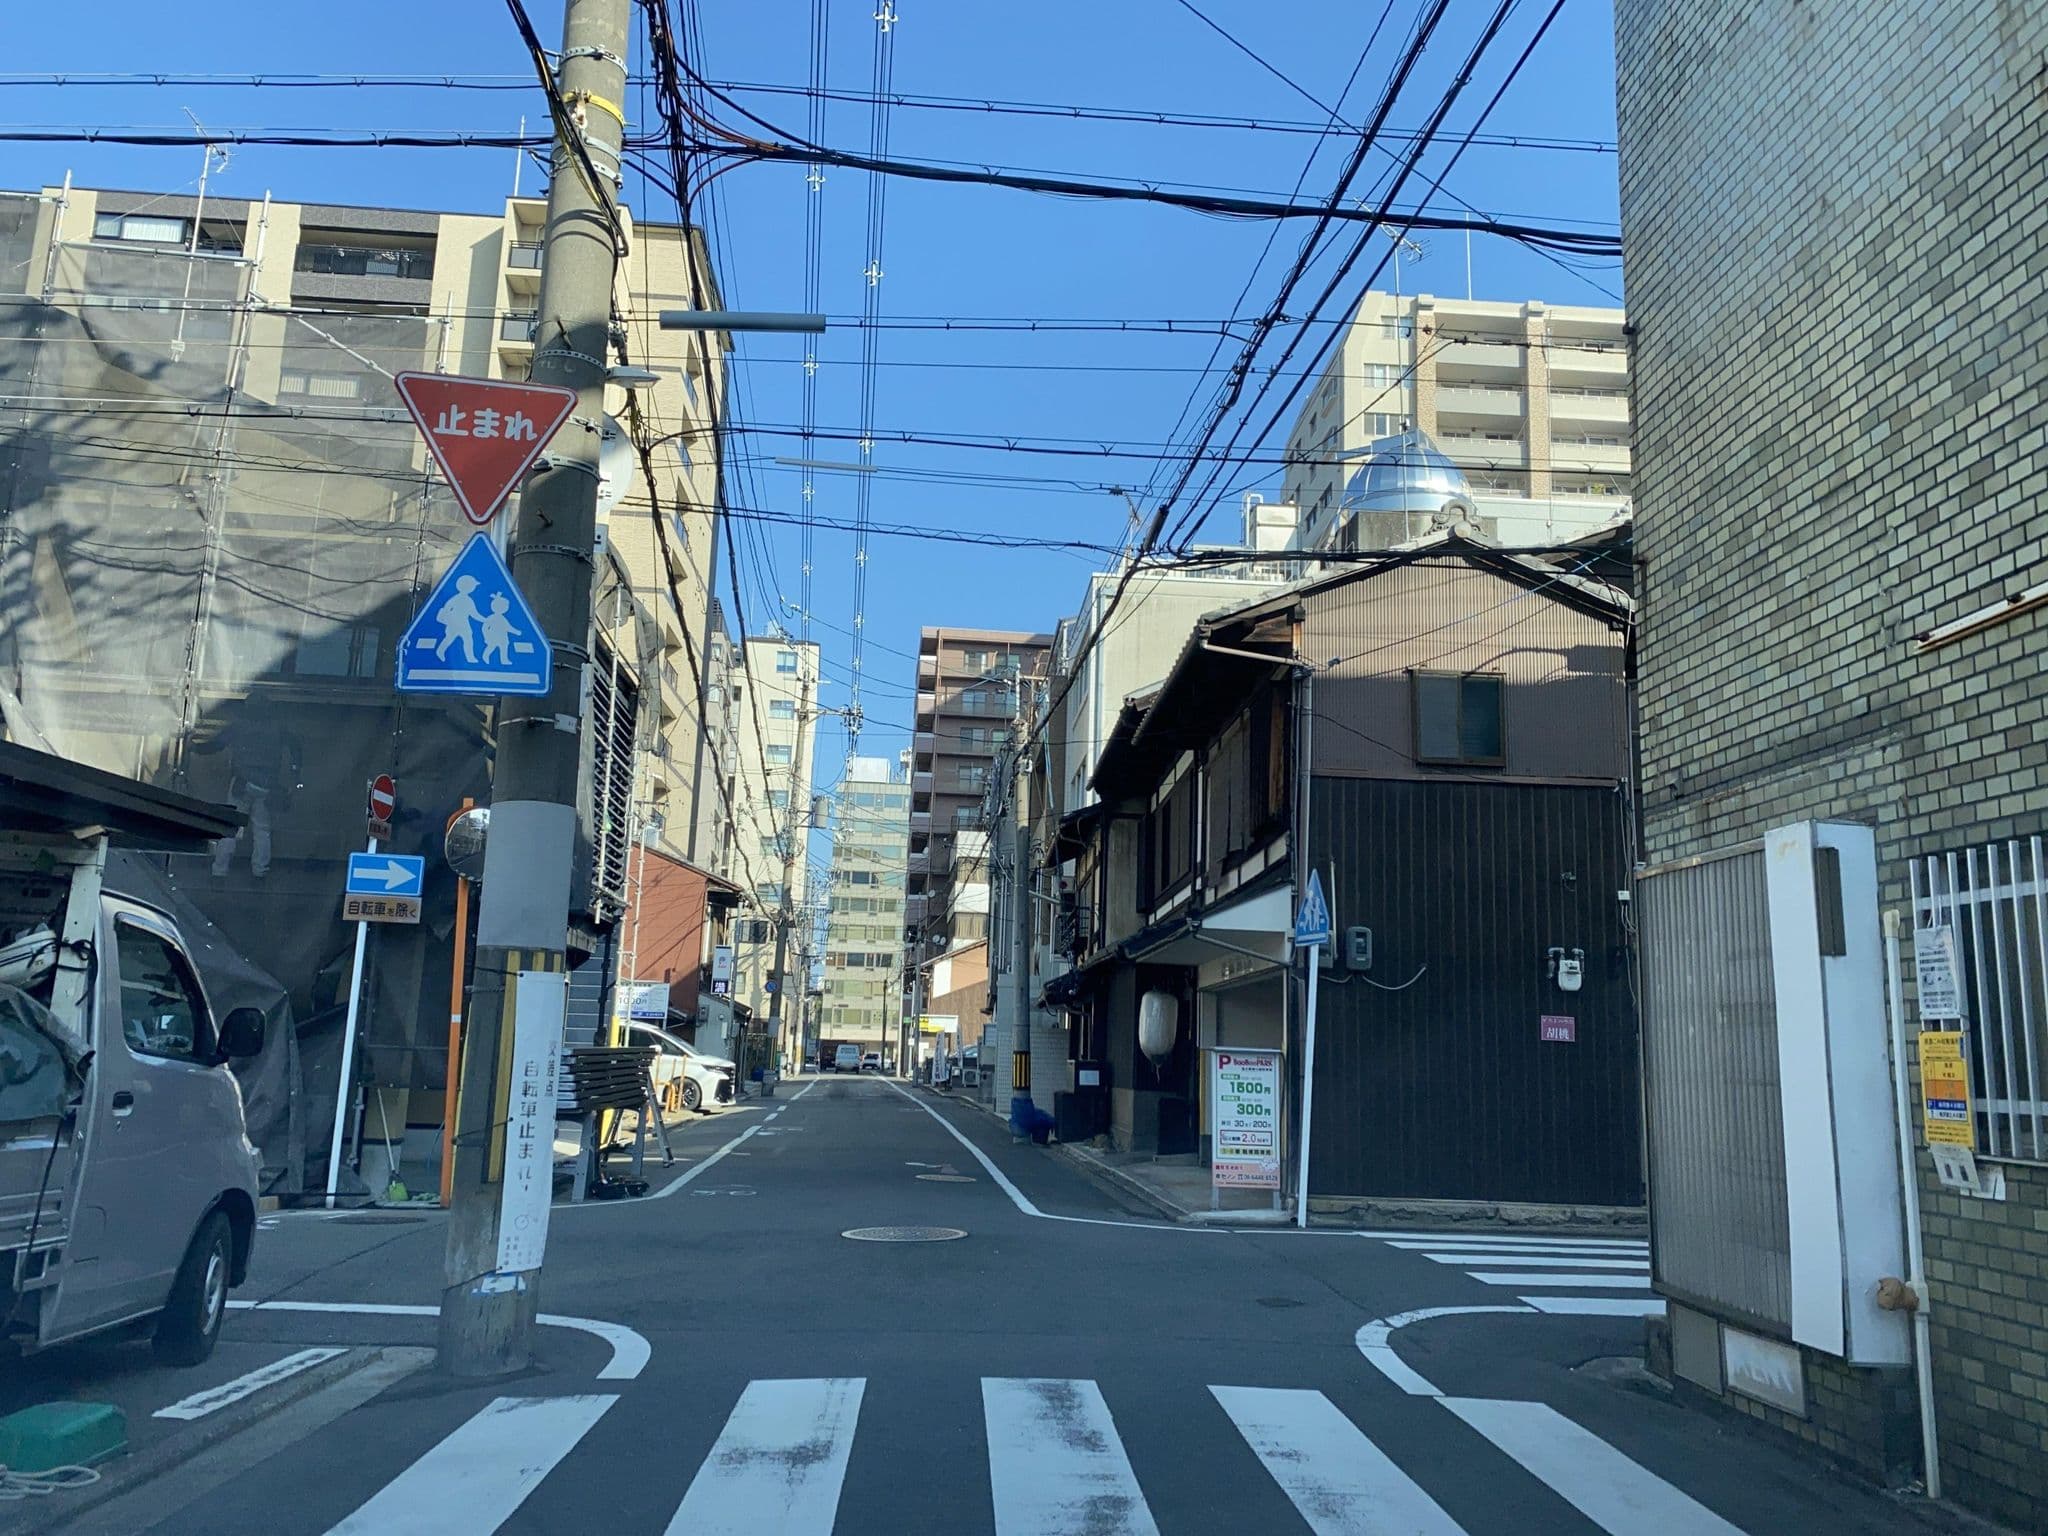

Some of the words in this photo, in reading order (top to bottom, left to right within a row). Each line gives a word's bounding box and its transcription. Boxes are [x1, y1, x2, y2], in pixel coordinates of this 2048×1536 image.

[433, 404, 537, 442] 止まれ
[347, 901, 418, 919] 自転車を除く
[1218, 1054, 1232, 1070] P
[1236, 1103, 1272, 1116] 300円
